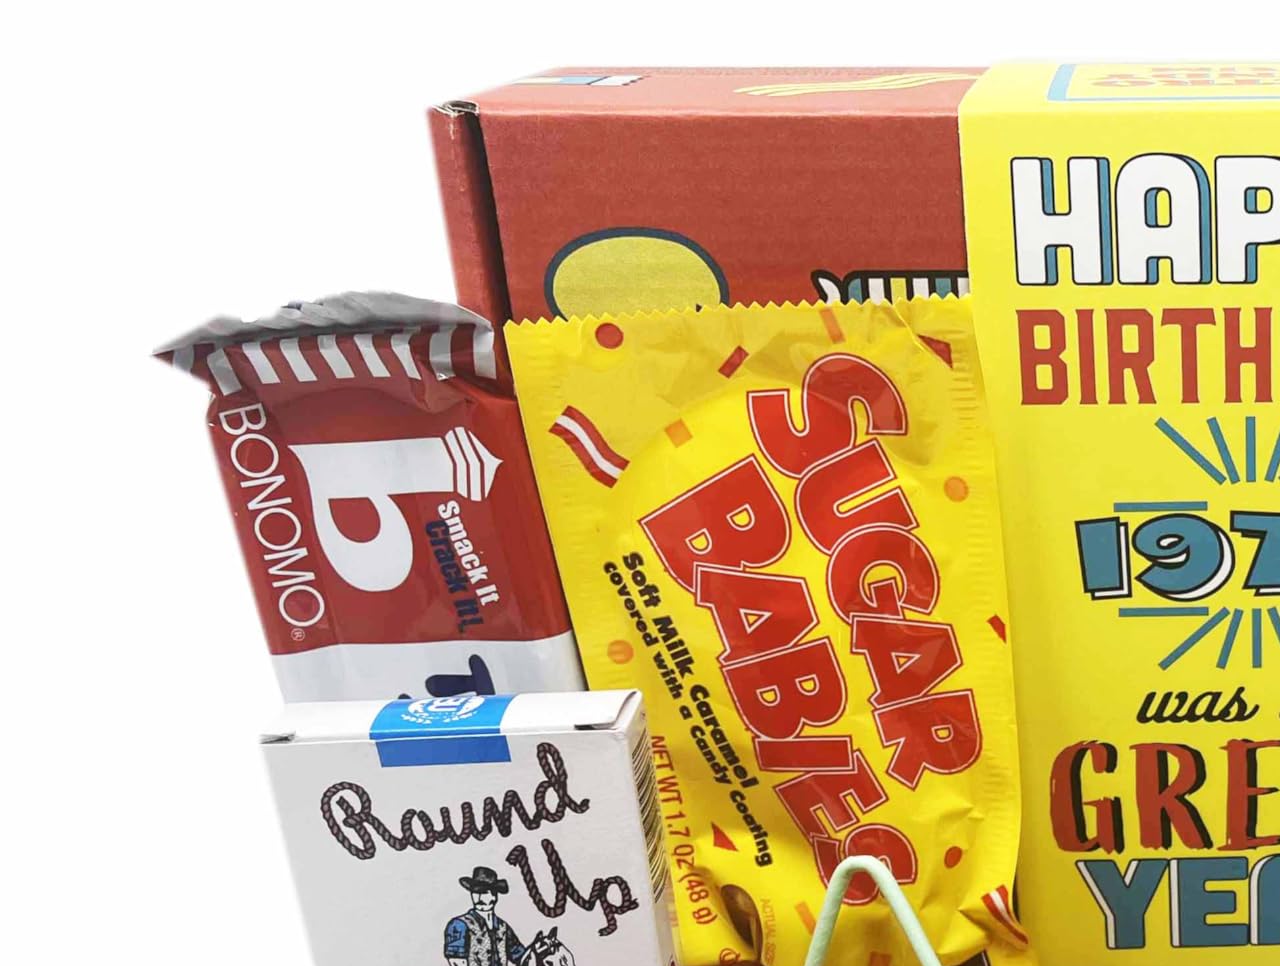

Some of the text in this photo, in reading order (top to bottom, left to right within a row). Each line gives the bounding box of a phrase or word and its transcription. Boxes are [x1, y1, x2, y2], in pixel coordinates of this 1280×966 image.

[218, 402, 326, 628] BONOMO
[425, 518, 469, 594] Crack
[436, 499, 489, 585] Smack
[745, 353, 983, 791] SUGAR
[603, 560, 660, 647] covered
[652, 651, 685, 700] with
[679, 704, 693, 720] a
[622, 551, 760, 789] Soft Milk Caramel
[639, 453, 919, 906] BABIES
[1136, 687, 1260, 723] was
[320, 742, 590, 860] Round
[651, 735, 719, 925] NET WT 1.7 OZ (48 g)
[505, 838, 640, 937] Up
